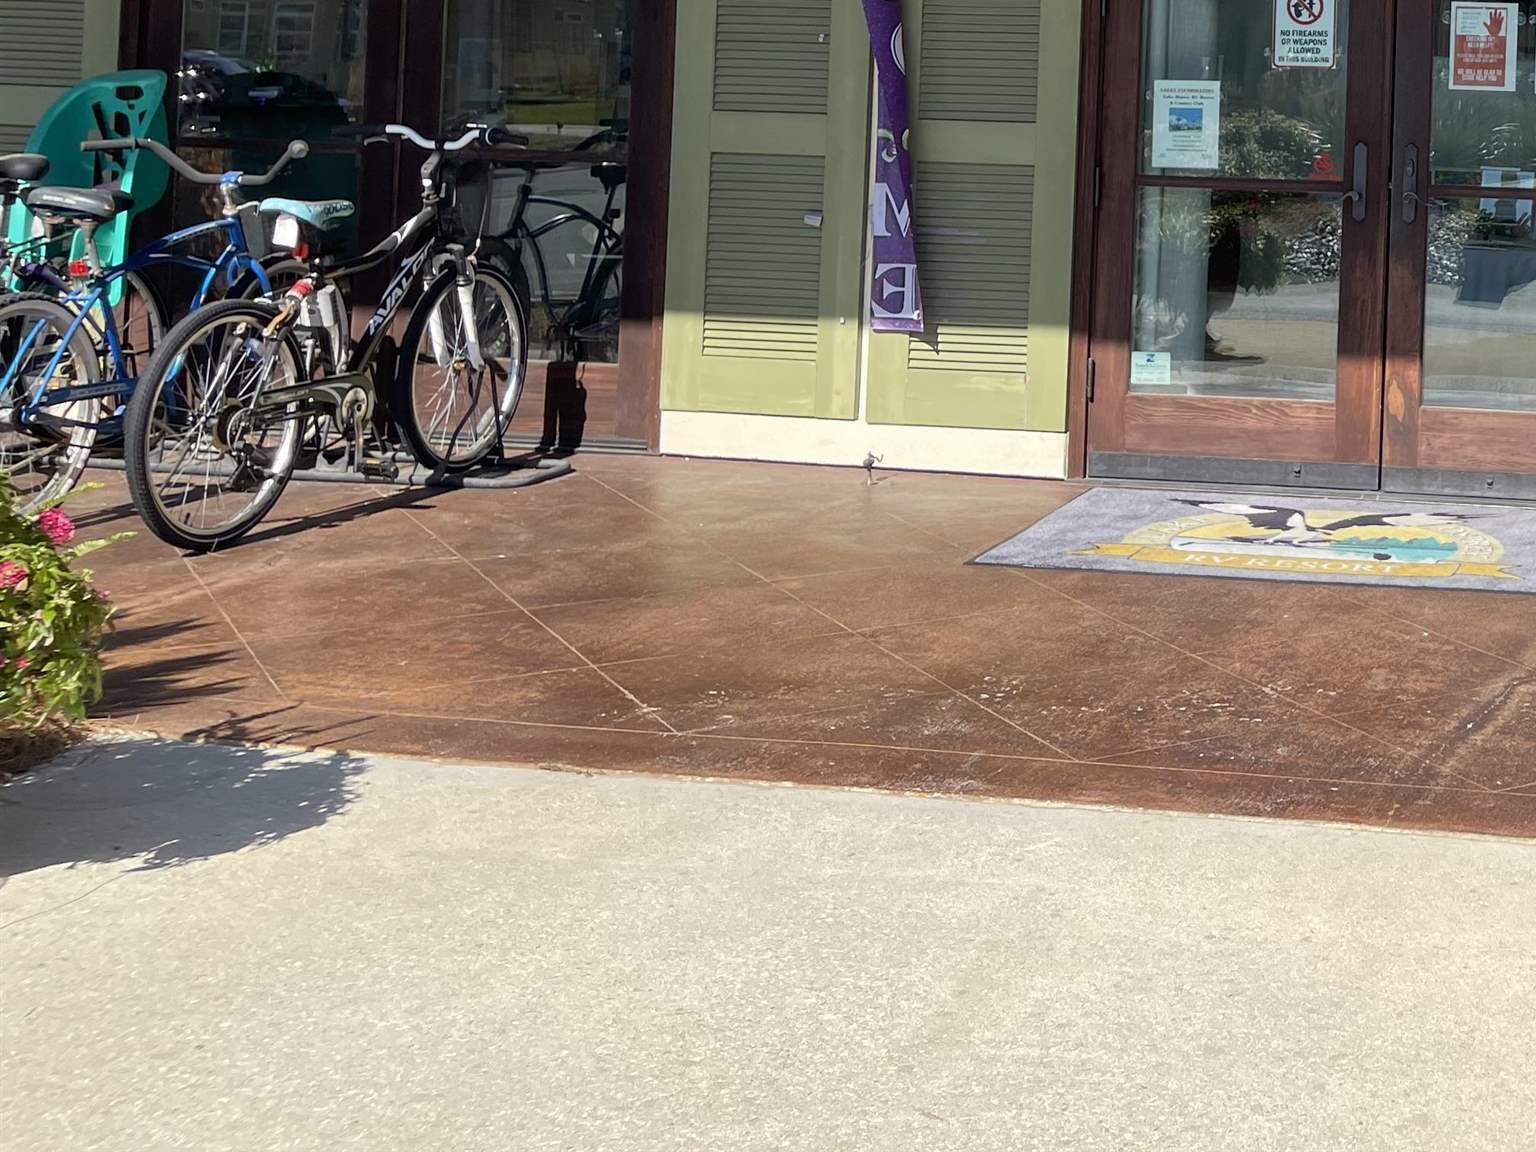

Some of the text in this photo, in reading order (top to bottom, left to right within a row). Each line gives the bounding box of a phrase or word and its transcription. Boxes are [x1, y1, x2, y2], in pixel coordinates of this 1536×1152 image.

[1292, 38, 1327, 46] WEAPONS
[1287, 47, 1321, 55] ALLOWED
[1183, 553, 1403, 574] RV RESORT
